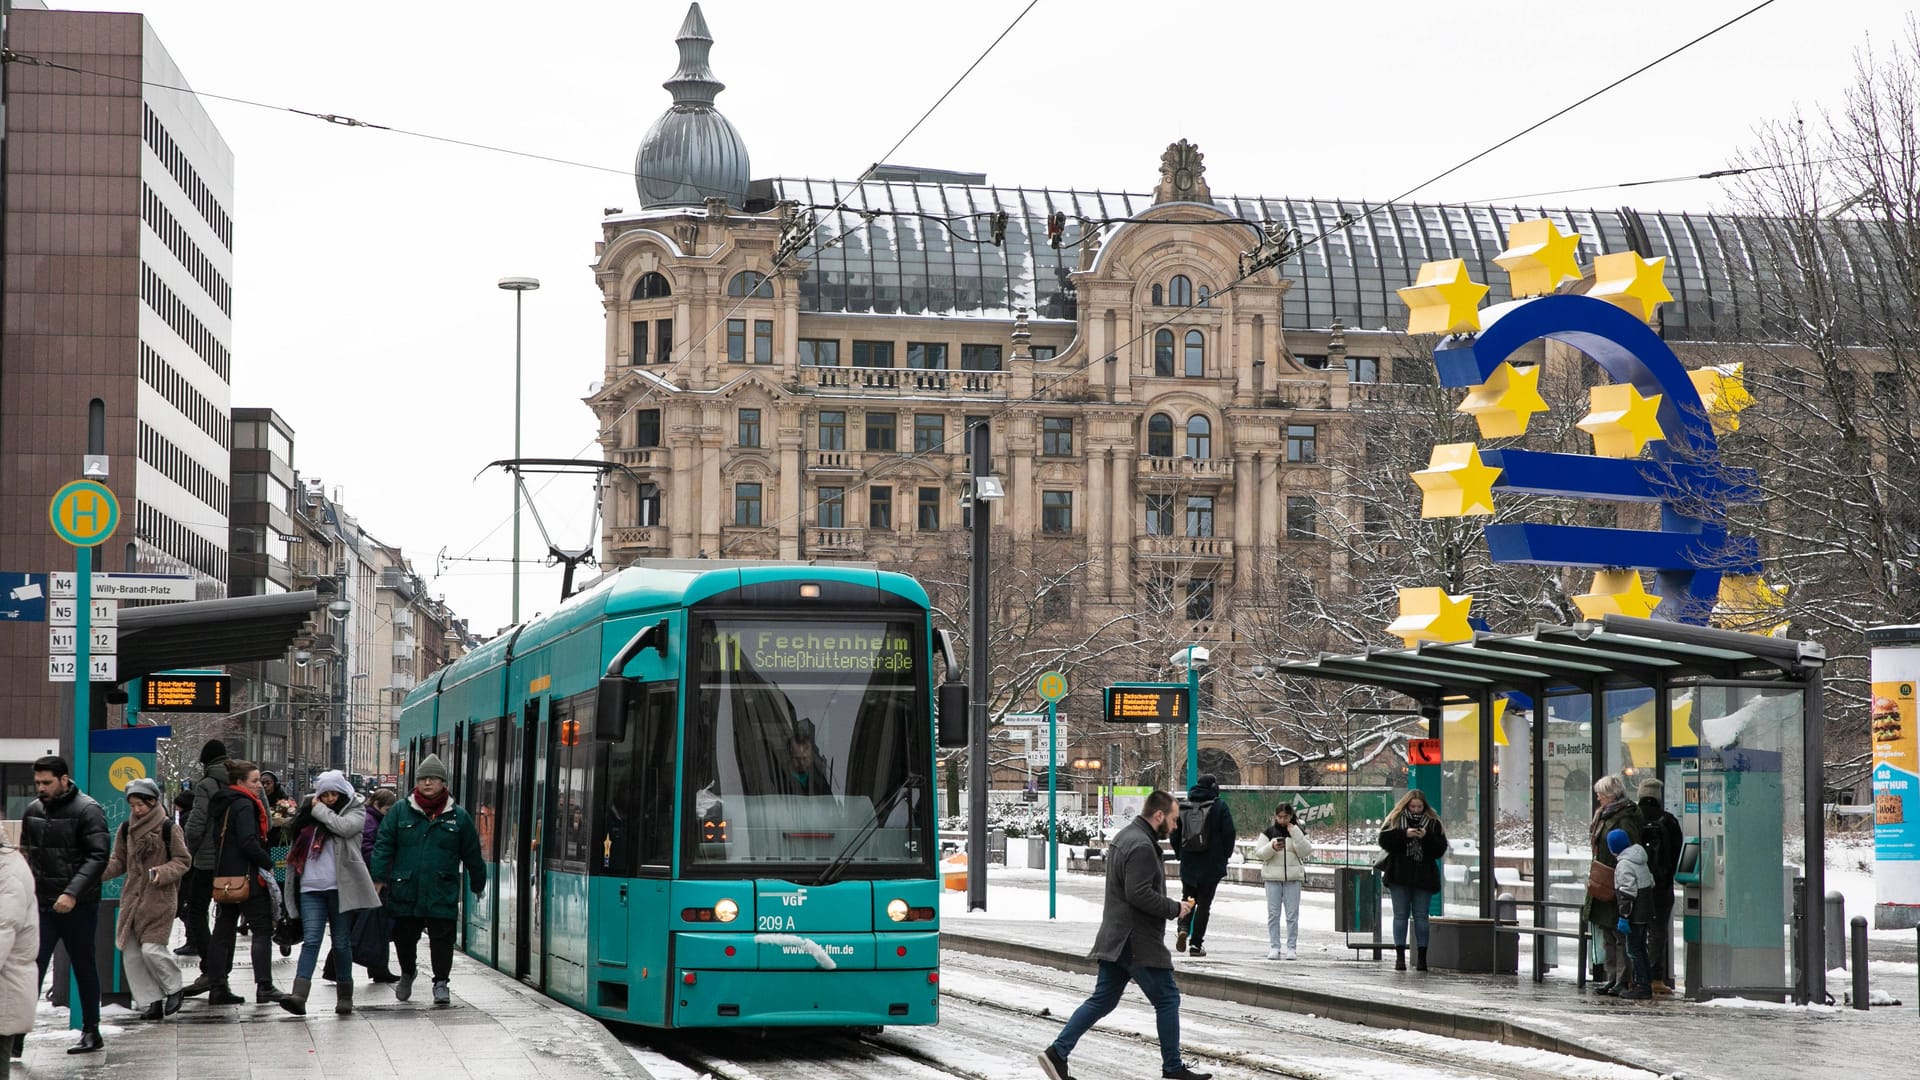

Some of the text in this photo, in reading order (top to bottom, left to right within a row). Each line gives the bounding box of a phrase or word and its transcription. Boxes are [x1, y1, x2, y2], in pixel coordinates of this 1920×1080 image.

[72, 495, 98, 531] H
[56, 579, 71, 590] N4
[96, 584, 171, 595] Willy-Brandt-Platz
[56, 607, 72, 618] N5
[95, 606, 107, 617] 11
[53, 635, 72, 646] N11
[95, 634, 108, 646] 12
[758, 632, 908, 650] Fechenheim
[714, 632, 741, 671] 11
[755, 651, 913, 672] Schießhüttenstraße
[51, 662, 74, 673] N12
[94, 662, 107, 673] 14
[1880, 805, 1897, 814] Wolt
[782, 889, 807, 906] VGF
[759, 915, 796, 930] 209 A
